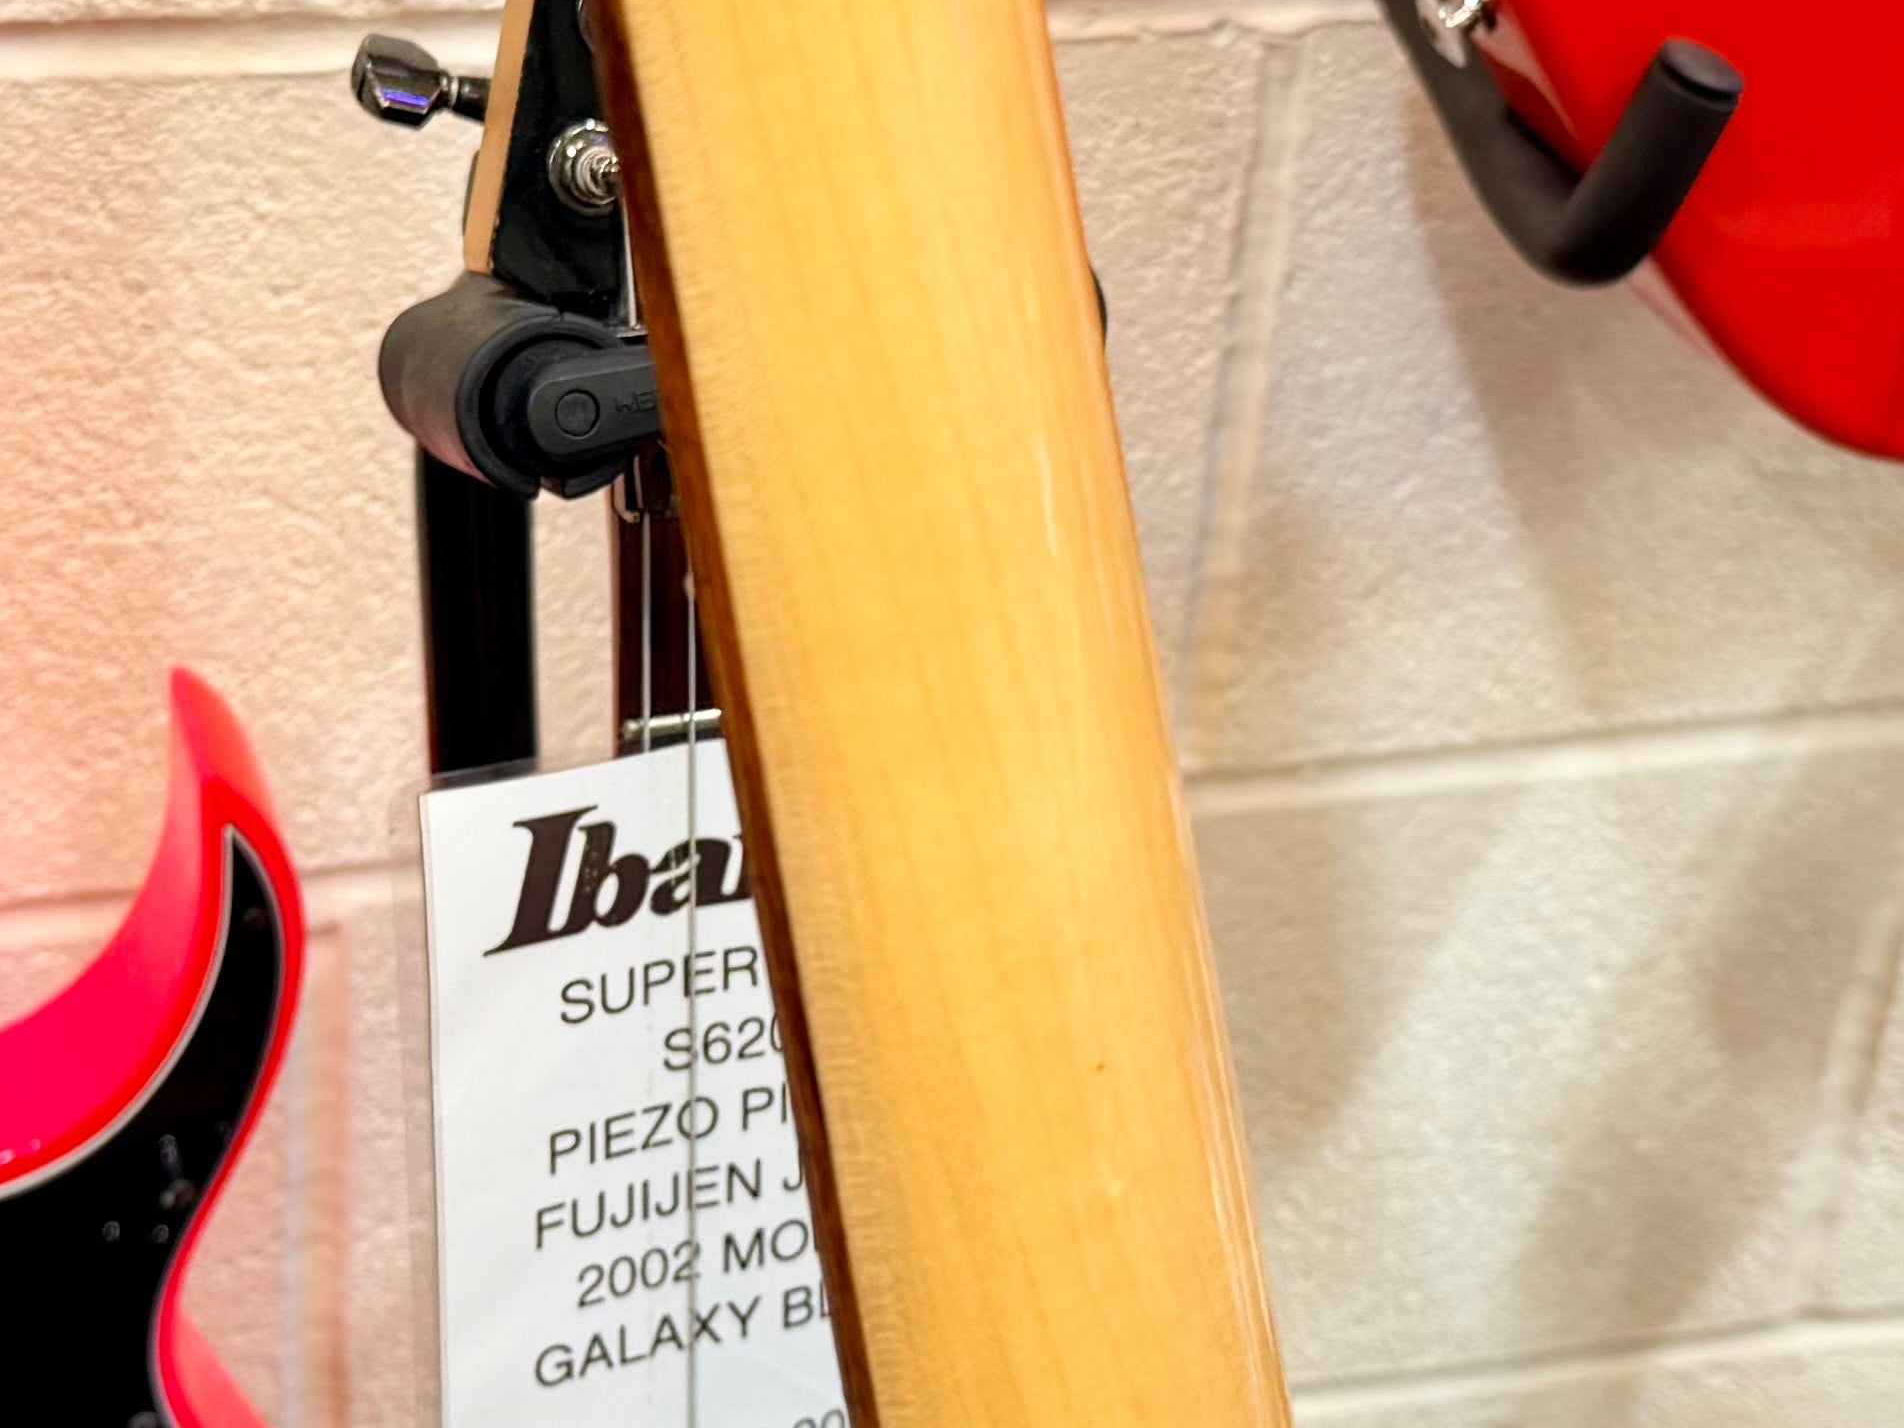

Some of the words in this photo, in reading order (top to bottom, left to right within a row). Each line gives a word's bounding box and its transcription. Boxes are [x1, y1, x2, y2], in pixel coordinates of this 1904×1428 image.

[482, 805, 755, 958] Iba
[559, 945, 758, 1025] SUPER
[547, 1095, 719, 1175] PIEZO
[534, 1158, 761, 1250] FUJIJEN
[577, 1240, 702, 1308] 2002
[723, 1219, 819, 1274] MO
[534, 1294, 761, 1389] GALAXY
